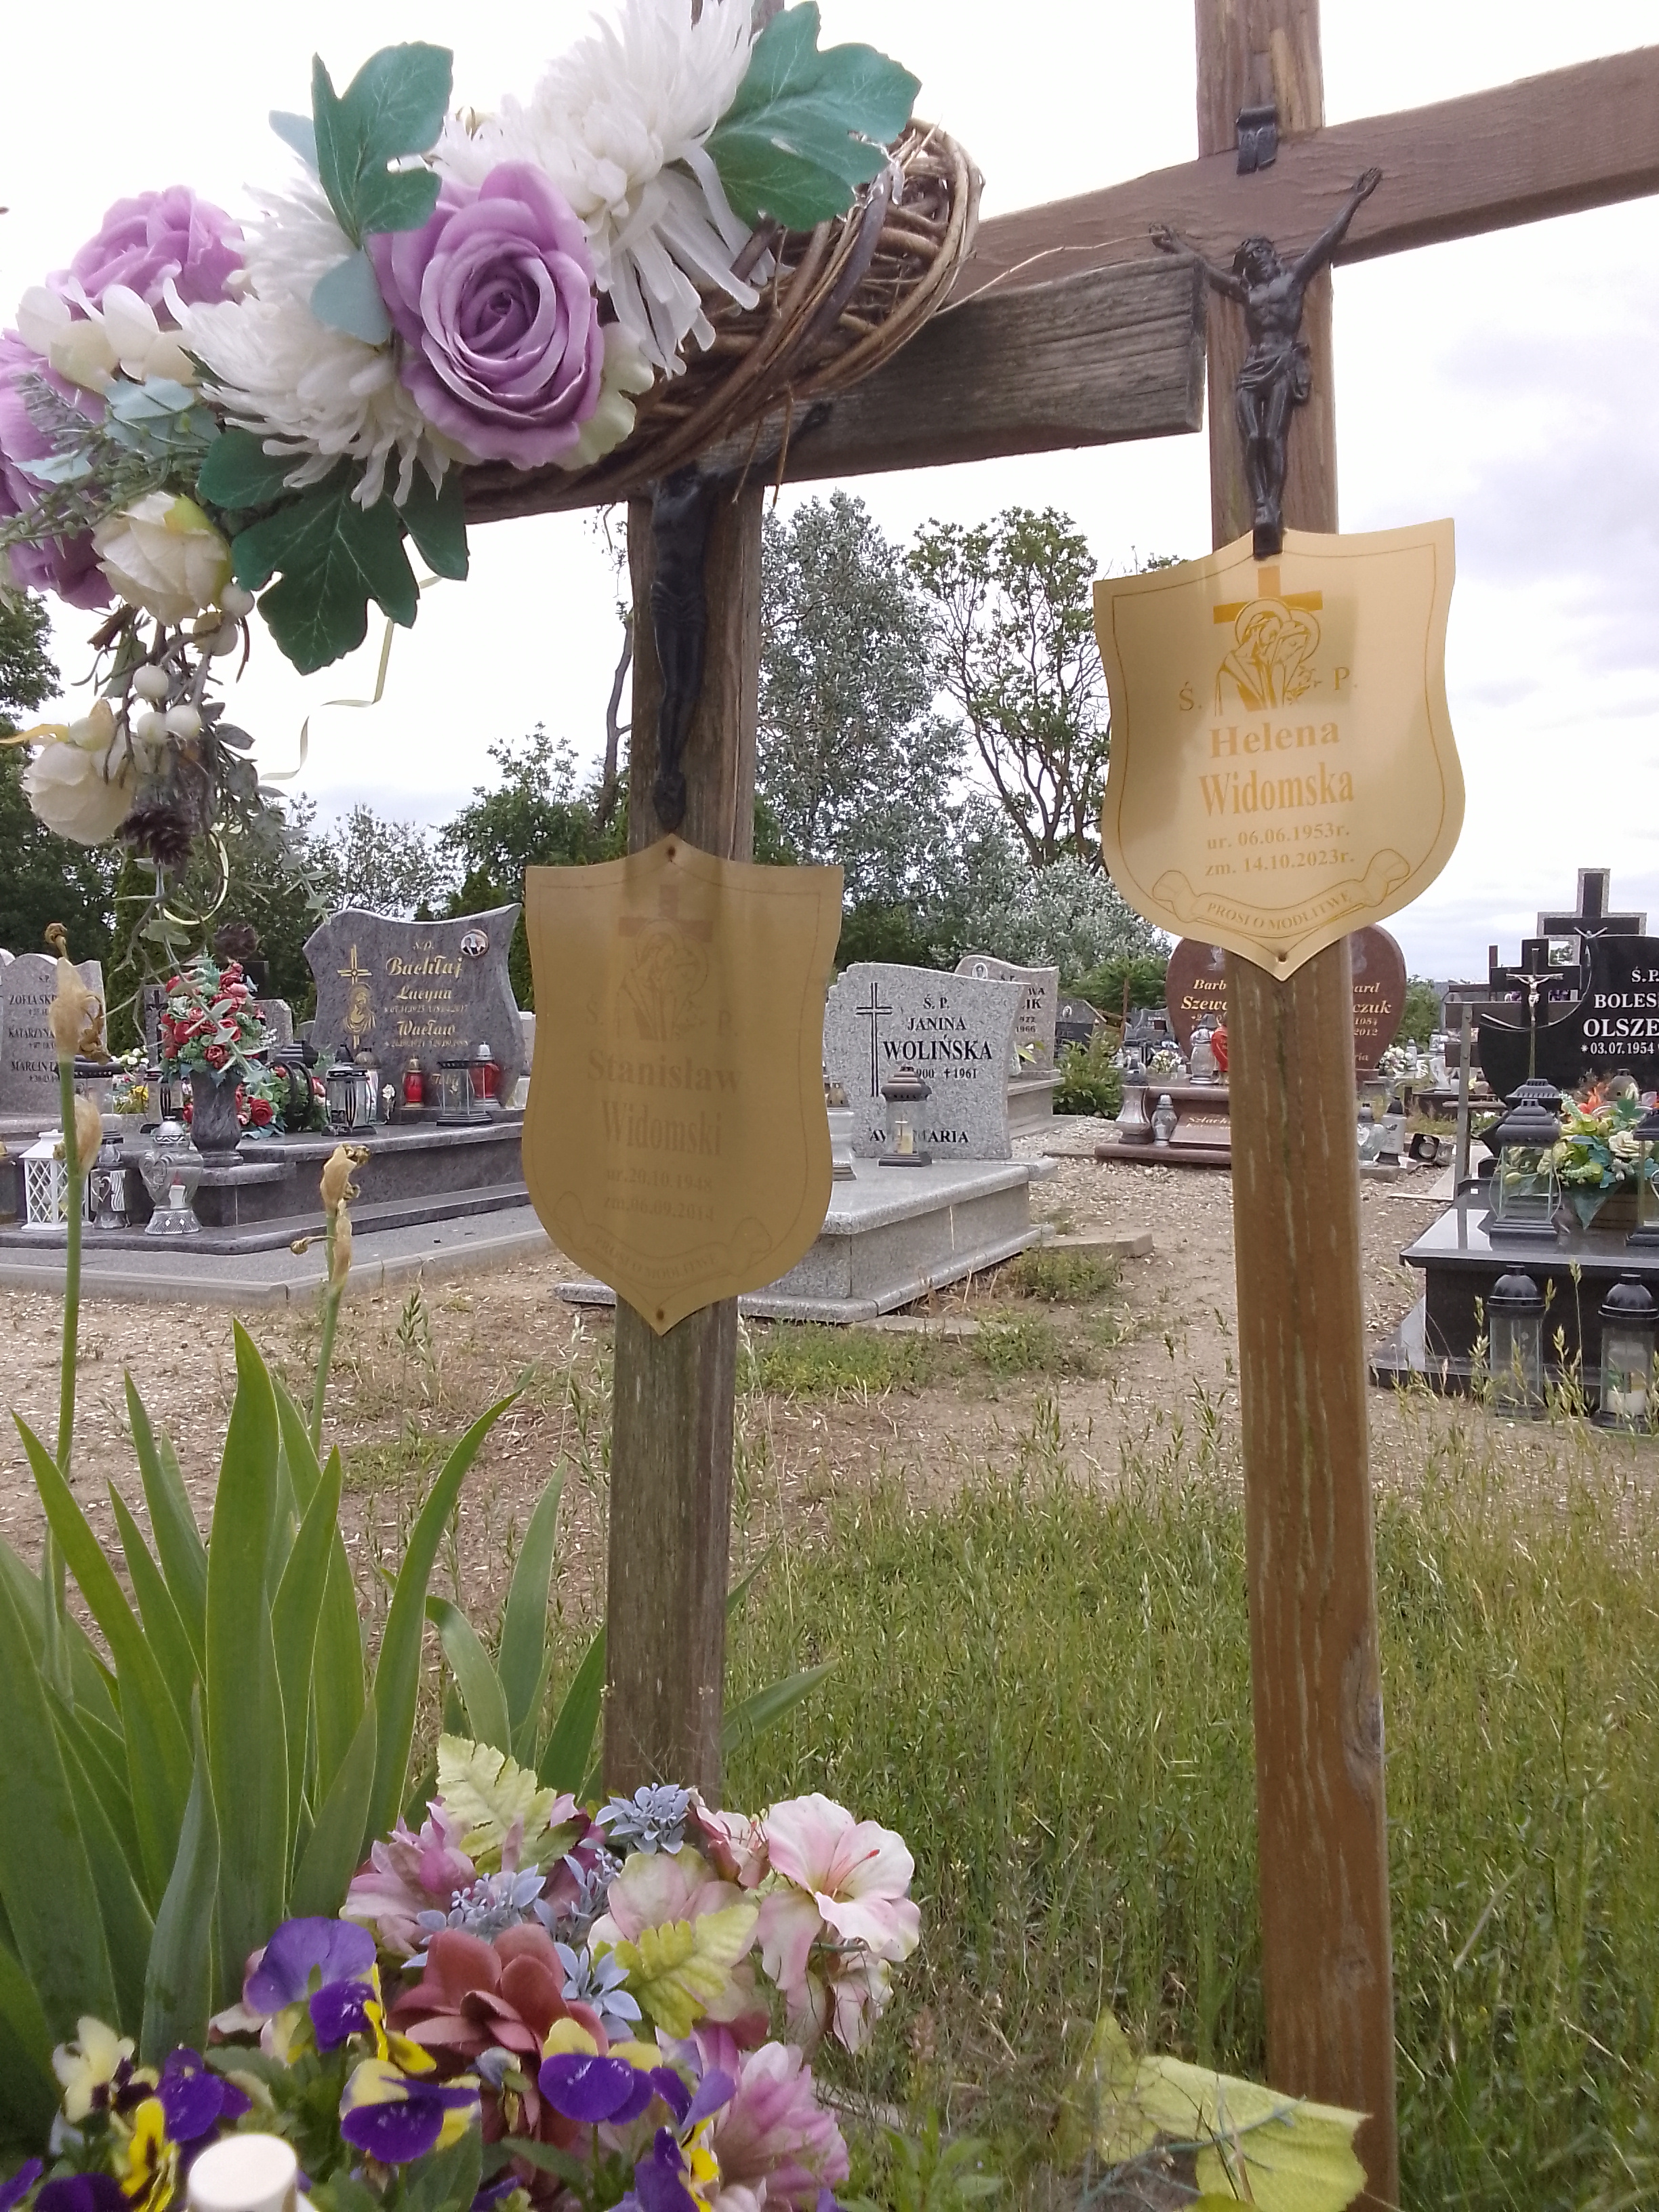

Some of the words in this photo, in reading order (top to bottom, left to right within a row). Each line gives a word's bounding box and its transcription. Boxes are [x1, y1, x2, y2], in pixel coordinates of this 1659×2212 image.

[1209, 722, 1340, 758] Helena
[1198, 762, 1354, 817] Widomska
[1208, 837, 1231, 849] ur.
[1206, 863, 1236, 876] zm.
[1207, 903, 1250, 925] PROSI
[1254, 918, 1264, 928] O
[1594, 993, 1659, 1008] BOLES
[907, 1017, 966, 1031] JANINA
[882, 1034, 992, 1060] WOLIŃSKA
[588, 1048, 741, 1094] Stanisław
[601, 1100, 722, 1156] Widomski
